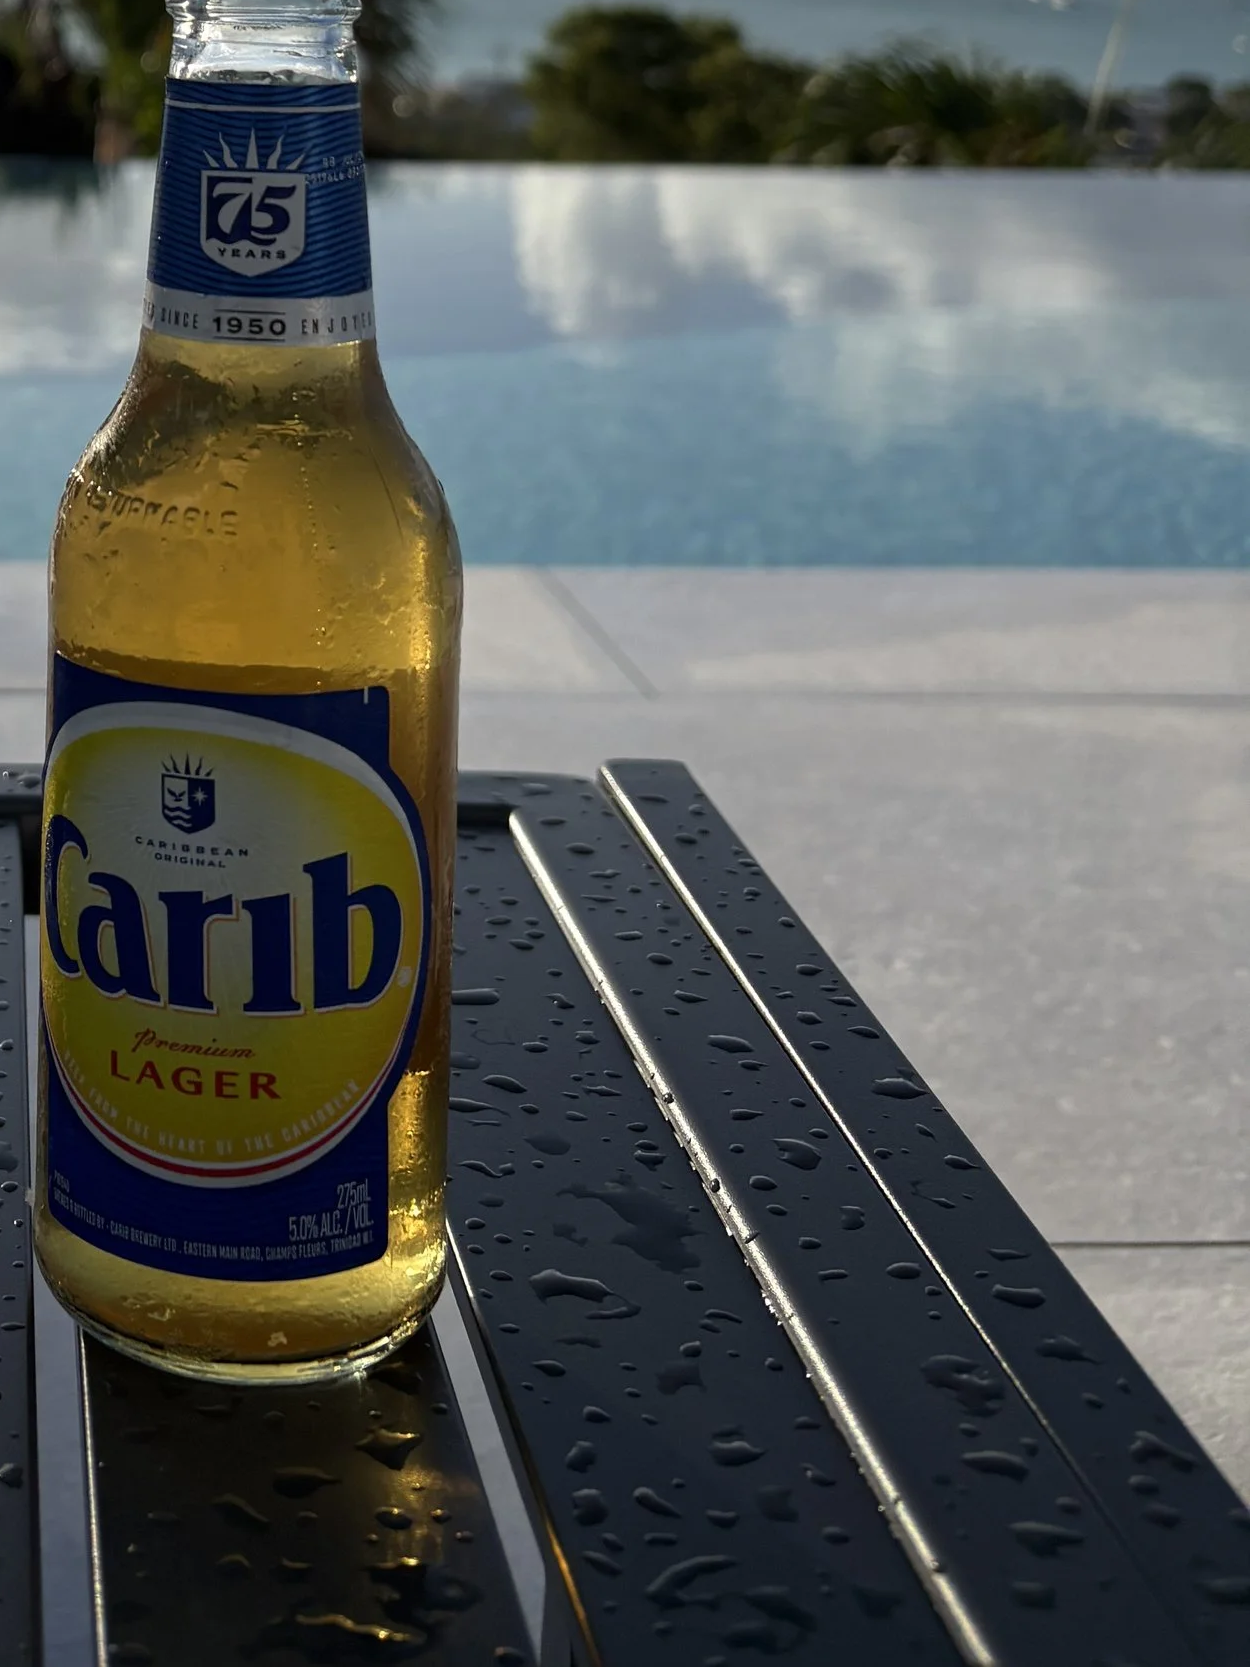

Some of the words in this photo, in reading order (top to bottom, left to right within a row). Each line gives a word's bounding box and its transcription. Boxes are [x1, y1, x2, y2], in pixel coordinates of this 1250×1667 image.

[207, 176, 297, 246] 75
[217, 247, 287, 260] YEARS
[160, 307, 199, 330] SINCE
[213, 316, 287, 335] 1950
[135, 835, 249, 856] CARIBBEAN
[154, 852, 226, 868] ORIGINAL
[44, 813, 406, 1017] Carib
[131, 1028, 255, 1058] Premium
[110, 1049, 281, 1100] LAGER
[126, 1116, 150, 1141] THE
[158, 1131, 206, 1155] HEART
[244, 1133, 273, 1152] THE
[337, 1178, 372, 1209] 275mL
[96, 1214, 106, 1230] BY
[130, 1227, 163, 1249] BREWERY
[183, 1240, 217, 1258] EASTERN
[219, 1244, 239, 1259] MAIN
[240, 1245, 264, 1262] ROAD,
[265, 1244, 297, 1261] CHAMPS
[288, 1214, 319, 1242] 5.0%
